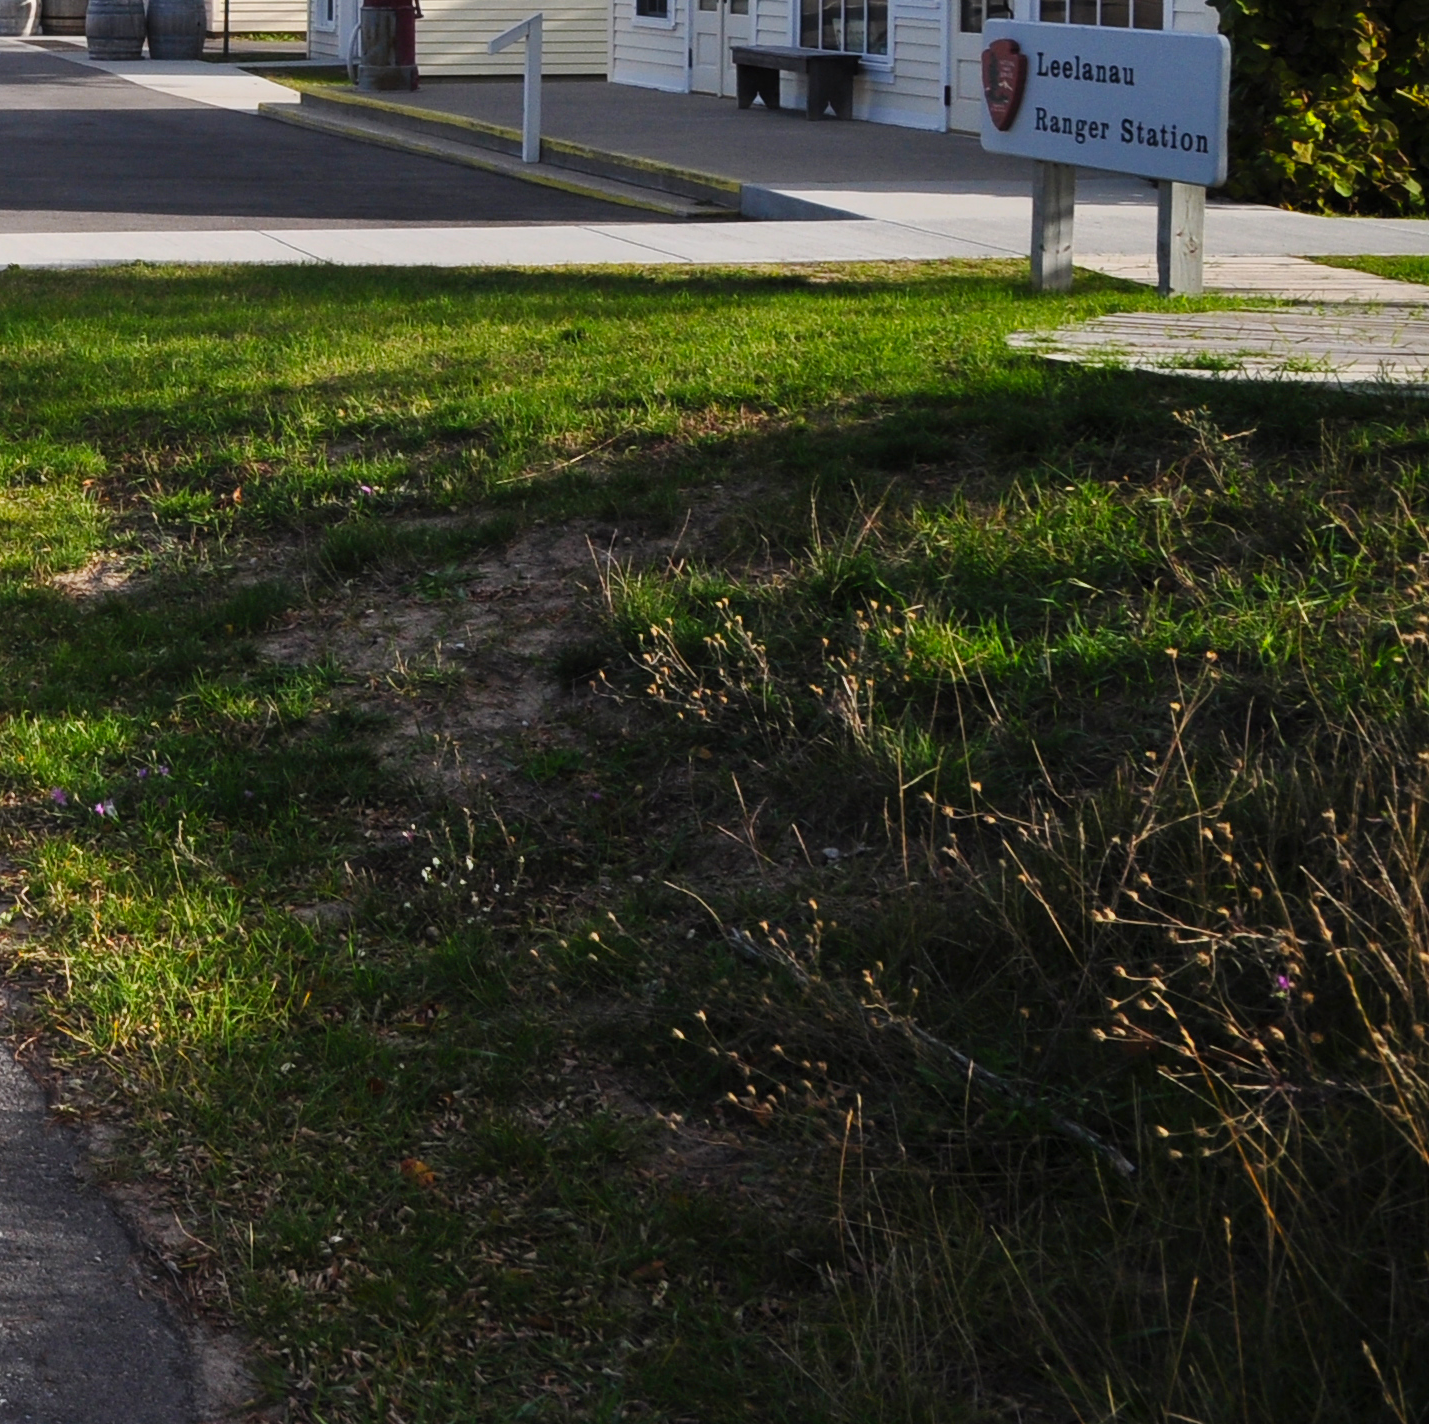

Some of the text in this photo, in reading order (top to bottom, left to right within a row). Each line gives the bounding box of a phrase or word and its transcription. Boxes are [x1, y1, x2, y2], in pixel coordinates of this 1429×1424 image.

[1036, 52, 1135, 86] Leelanau
[1035, 107, 1209, 153] Ranger Station
